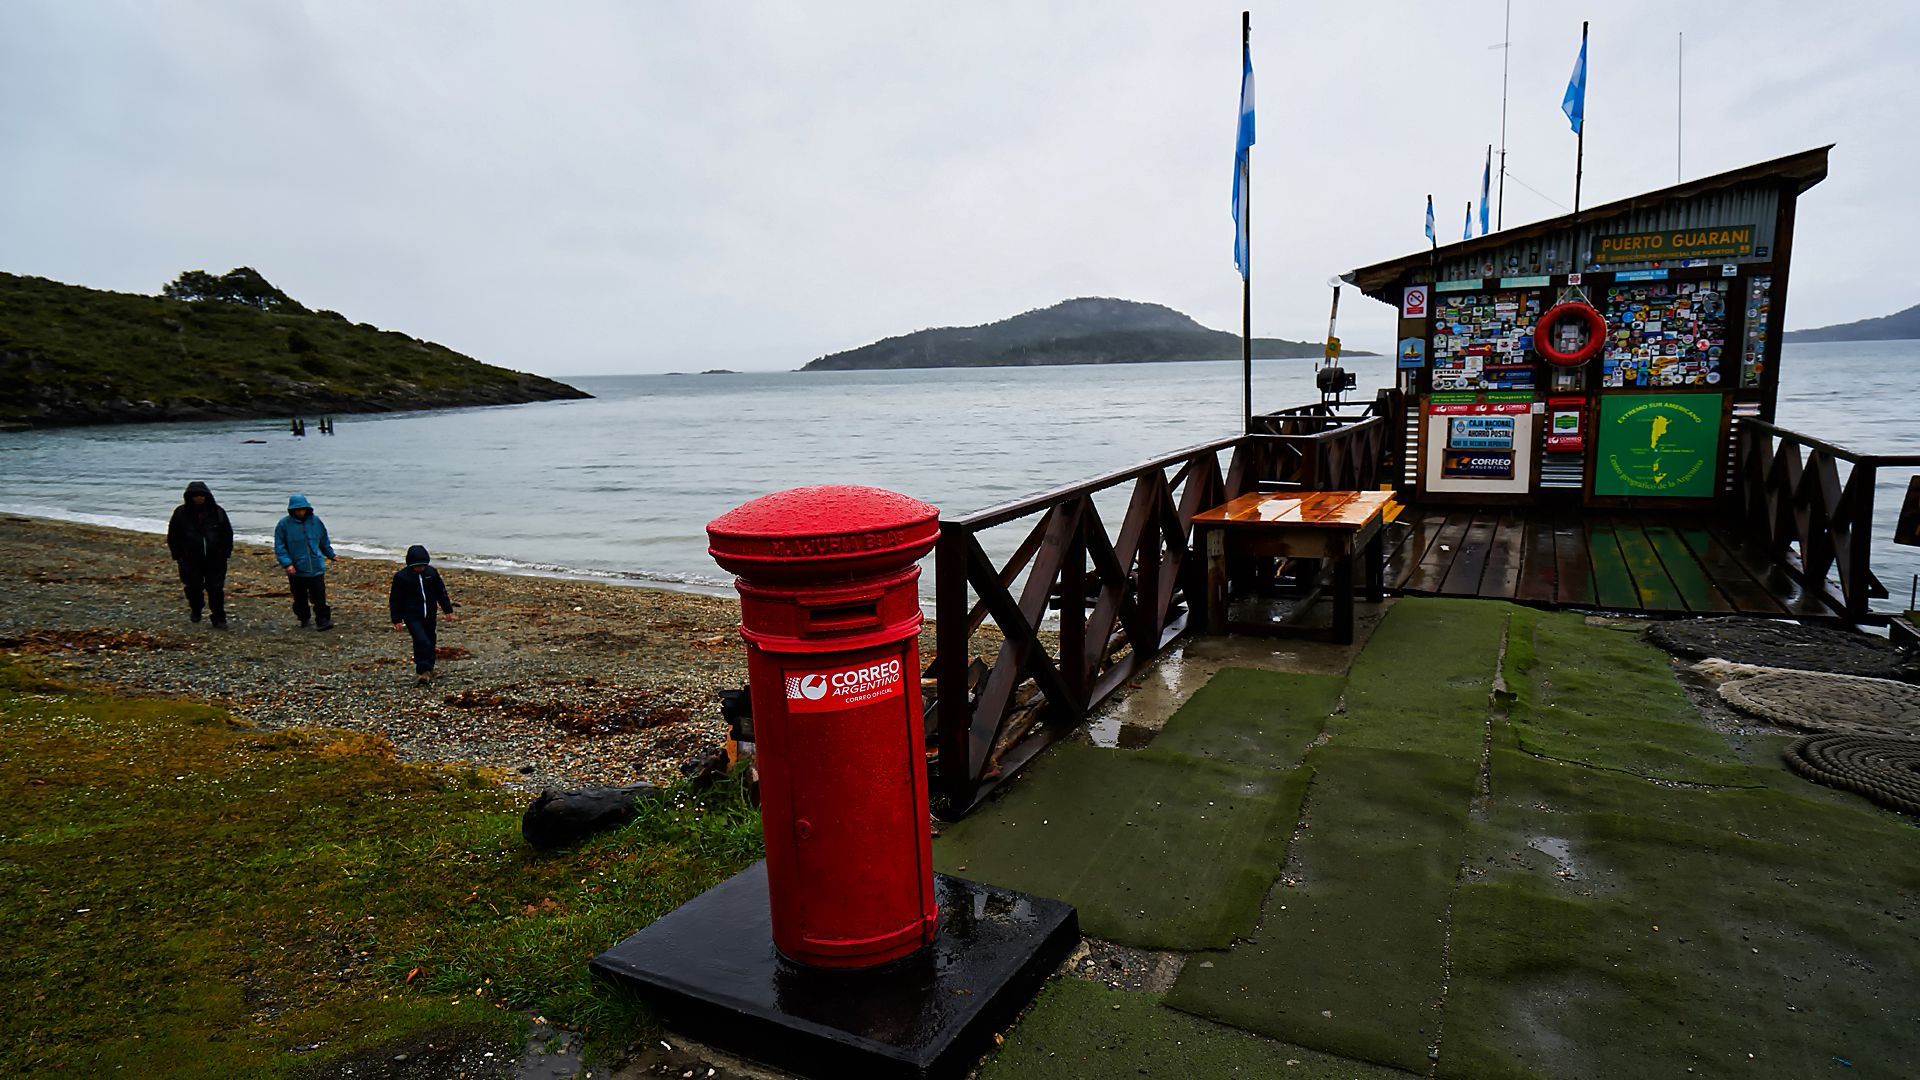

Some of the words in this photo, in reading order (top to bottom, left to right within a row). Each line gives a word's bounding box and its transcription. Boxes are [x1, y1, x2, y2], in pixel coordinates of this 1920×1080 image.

[1601, 235, 1663, 252] PUERTO
[1664, 402, 1702, 423] AMERICANO
[1491, 430, 1511, 438] POSTAL
[1471, 458, 1511, 466] CORREO
[831, 659, 900, 687] CORREO
[832, 673, 900, 697] ARGENTINO
[845, 694, 872, 703] CORREO
[872, 688, 893, 698] OFICIAL
